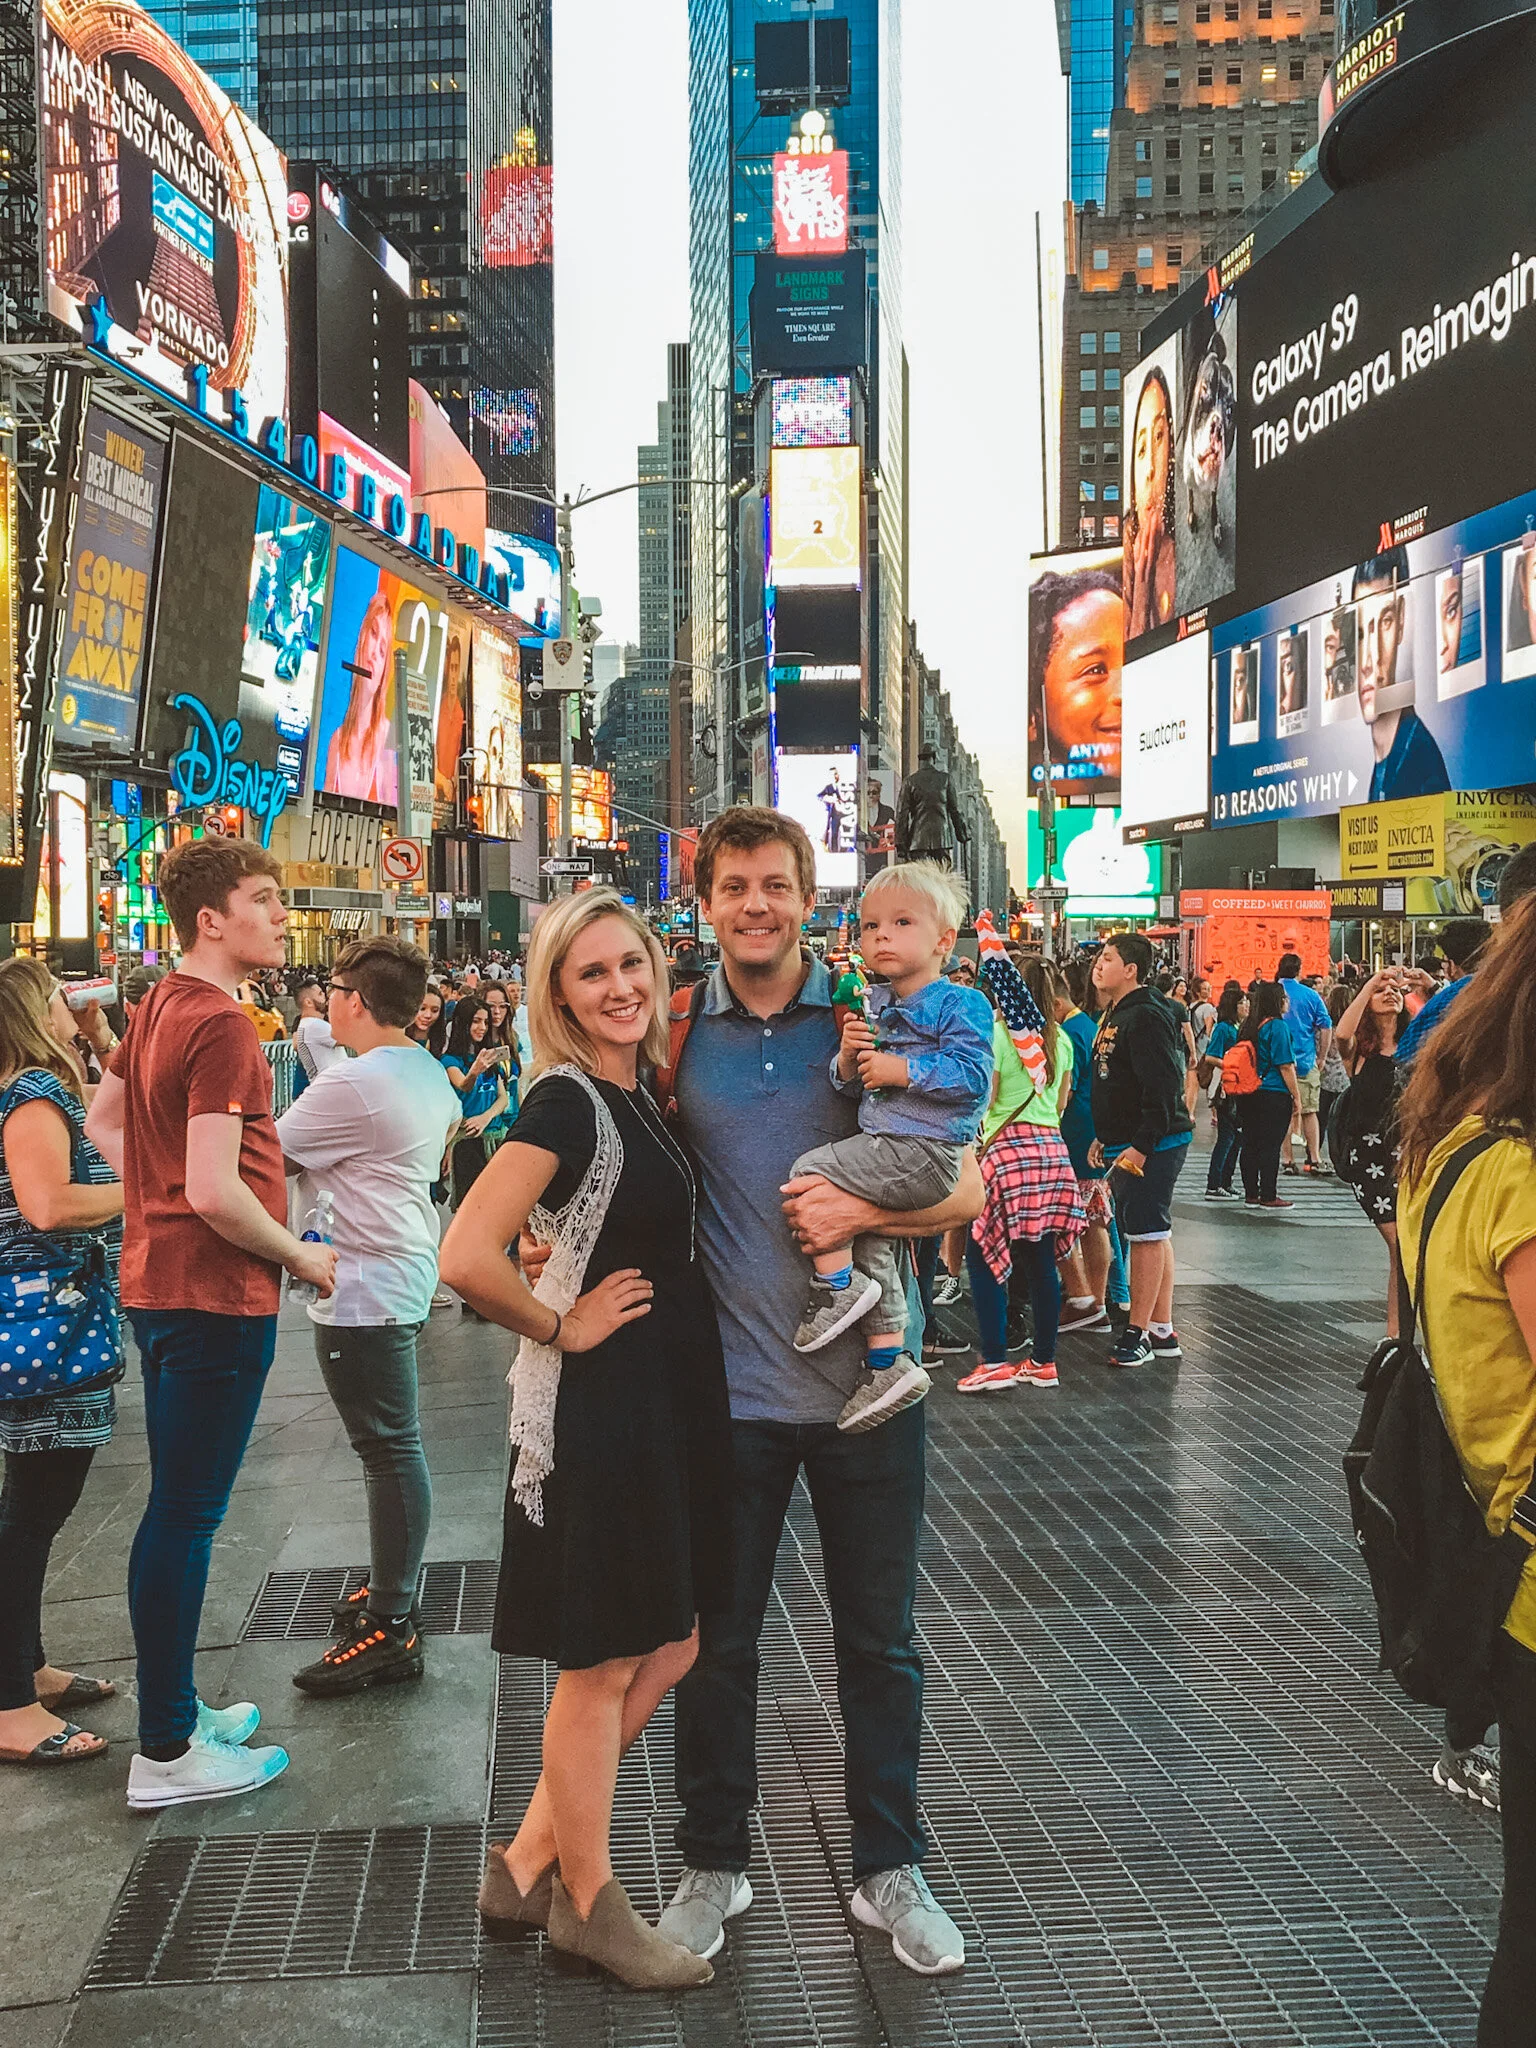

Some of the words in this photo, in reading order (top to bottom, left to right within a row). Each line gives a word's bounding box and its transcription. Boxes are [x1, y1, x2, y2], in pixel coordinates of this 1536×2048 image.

[1336, 12, 1406, 80] MARRIOTT
[1336, 44, 1395, 104] MARQUIS
[51, 37, 110, 114] MOST
[111, 92, 214, 212] SUSTAINABLE
[124, 69, 158, 123] NEW
[160, 103, 194, 159] YORK
[196, 141, 231, 191] CITY'S
[288, 225, 309, 242] LG
[1221, 232, 1256, 272] MARRIOTT
[776, 270, 844, 288] LANDMARK
[1221, 253, 1252, 288] MARQUIS
[790, 286, 829, 302] SIGNS
[135, 280, 229, 369] VORNADO
[784, 324, 807, 334] TIMES
[807, 322, 836, 333] SQUARE
[792, 333, 807, 342] Even
[807, 332, 830, 341] Greater
[1252, 321, 1327, 405] Galaxy
[1330, 293, 1359, 351] S9
[1251, 417, 1289, 470] The
[1292, 350, 1396, 443] Camera.
[86, 451, 113, 492] BEST
[813, 520, 823, 534] 2
[1394, 506, 1428, 529] MARRIOTT
[331, 453, 515, 608] BROADWAY
[1394, 520, 1425, 544] MARQUIS
[76, 549, 148, 613] COME
[66, 636, 140, 694] AWAY
[1139, 720, 1179, 753] swatch
[1256, 765, 1274, 777] NETFLIX
[1273, 760, 1293, 774] ORIGINAL
[1293, 756, 1309, 768] SERIES
[1214, 794, 1227, 820] 13
[1231, 780, 1298, 817] REASONS
[1303, 769, 1343, 803] WHY
[1456, 791, 1534, 806] INVICTA
[1348, 817, 1367, 837] VISIT
[1368, 816, 1378, 834] US
[1456, 811, 1496, 819] INVINCIBLE
[308, 807, 384, 869] FOREVER
[1388, 825, 1434, 847] INVICTA
[1348, 841, 1362, 856] NEXT
[1363, 840, 1378, 855] DOOR
[547, 862, 561, 871] ONE
[570, 862, 586, 870] WAY
[1212, 898, 1266, 909] COFFEED
[1271, 899, 1293, 910] SWEET
[1295, 899, 1327, 909] CHURROS
[1331, 887, 1357, 907] COMING
[1358, 886, 1378, 906] SOON
[329, 909, 362, 930] FOREVER
